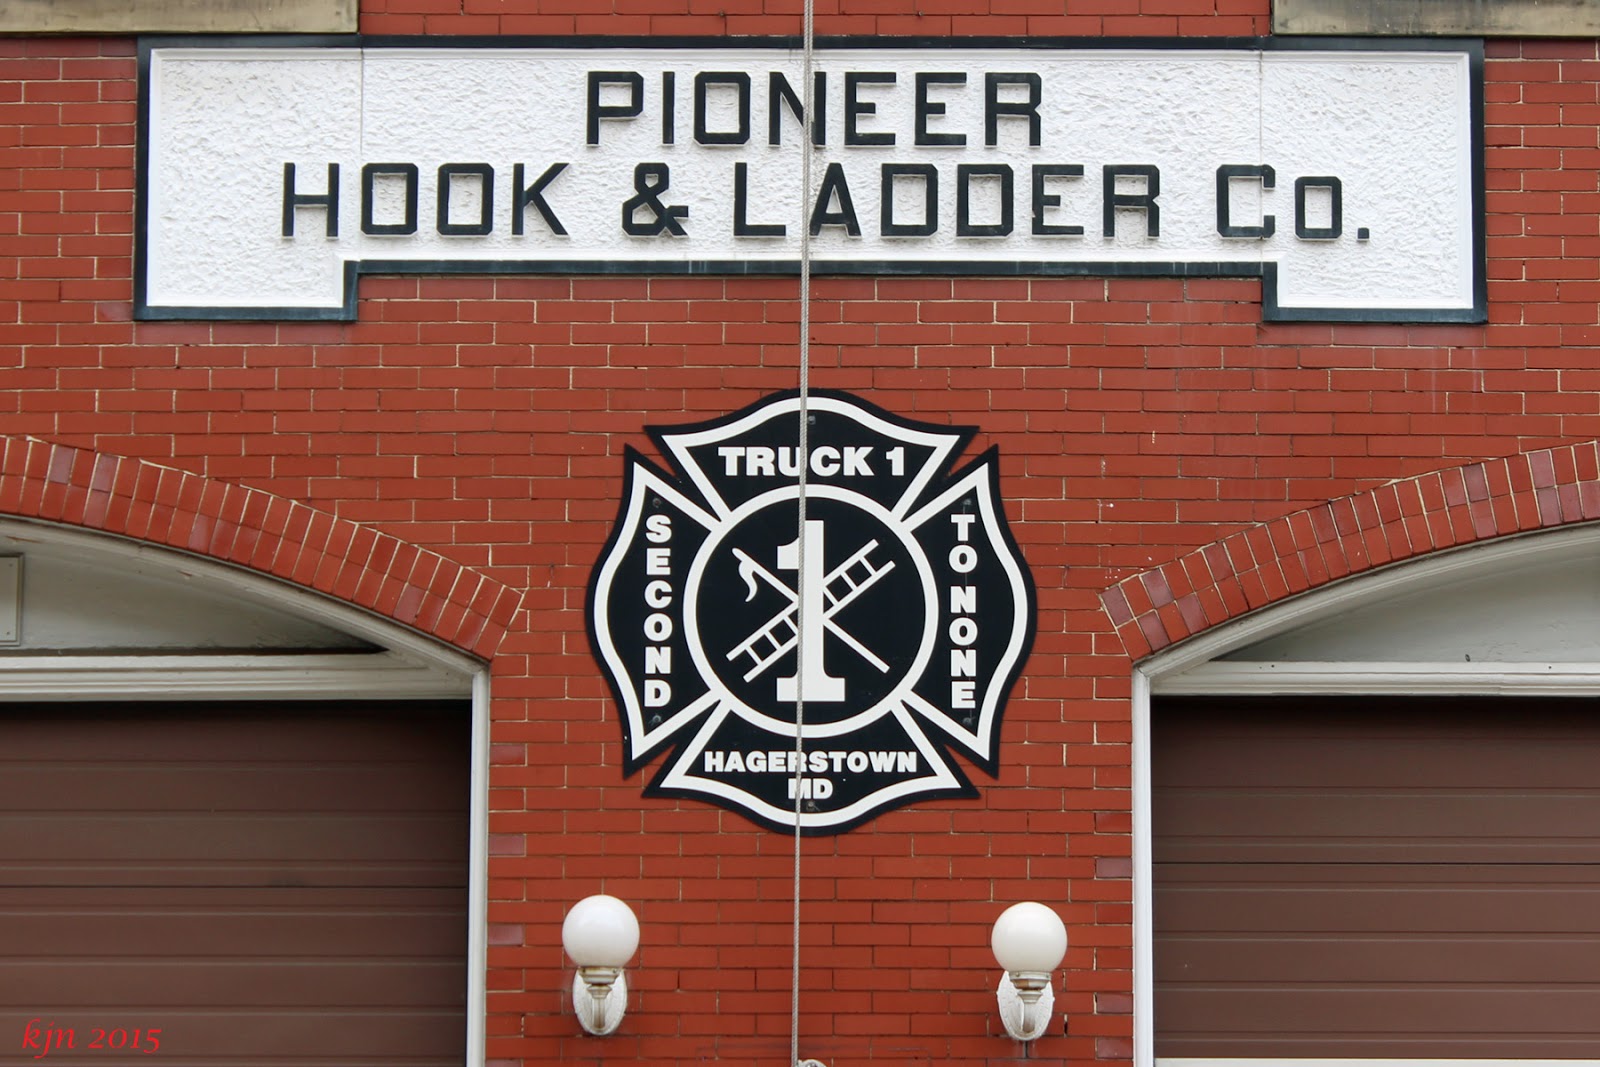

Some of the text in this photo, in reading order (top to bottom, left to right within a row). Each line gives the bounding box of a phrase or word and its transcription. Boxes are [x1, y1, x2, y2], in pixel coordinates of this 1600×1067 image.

[586, 71, 1042, 147] PIONEER
[282, 162, 570, 237] HOOK
[621, 162, 689, 237] &
[733, 162, 1161, 239] LADDER
[717, 446, 905, 477] TRUCK 1
[645, 514, 672, 707] SECOND
[776, 519, 846, 702] 1
[704, 750, 917, 774] HAGERSTOWN
[787, 778, 834, 800] MD
